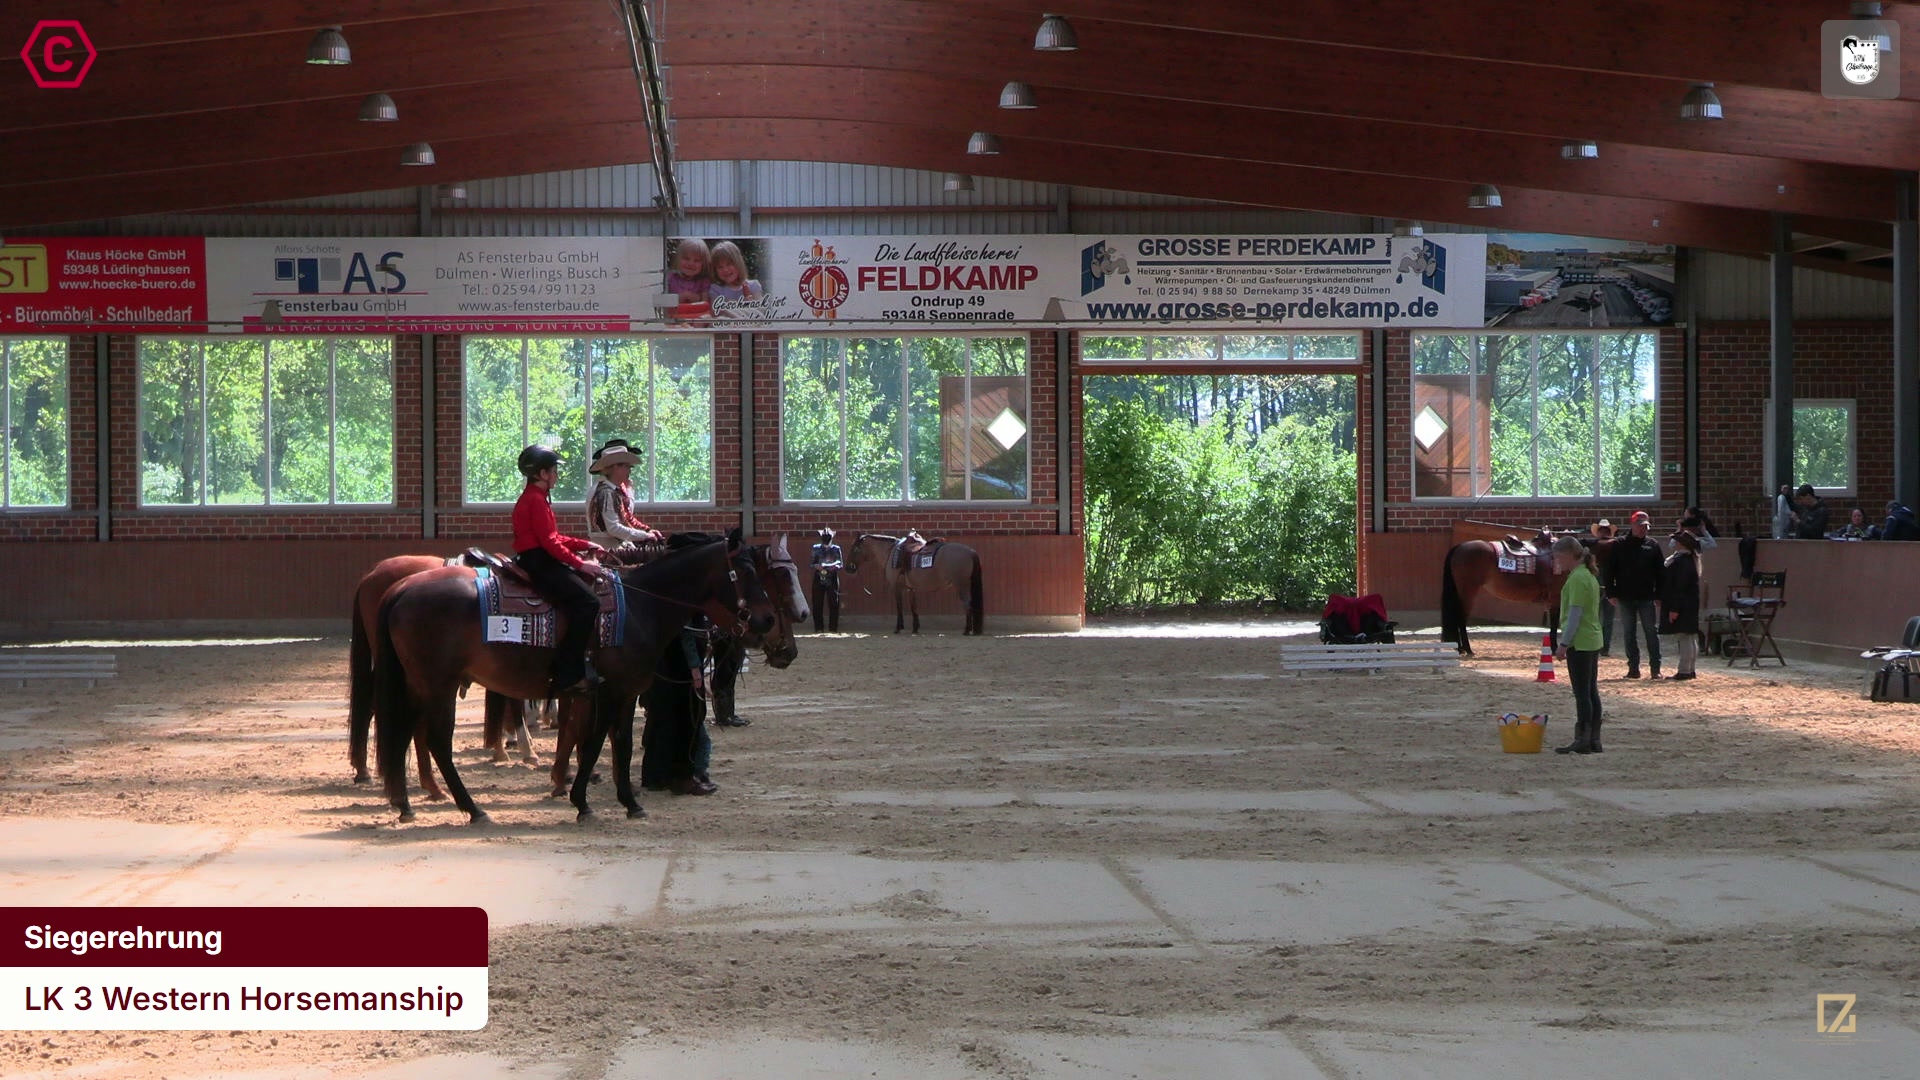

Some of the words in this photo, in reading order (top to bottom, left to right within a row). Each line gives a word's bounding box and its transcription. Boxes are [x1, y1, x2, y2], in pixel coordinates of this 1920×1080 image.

[66, 249, 102, 260] Klaus
[105, 248, 145, 260] Höcke
[147, 249, 187, 260] GmbH
[874, 243, 900, 263] Die
[904, 242, 1021, 266] Landfleischerei
[1138, 238, 1231, 256] GROSSE
[1237, 237, 1376, 257] PERDEKAMP
[457, 252, 474, 263] AS
[479, 251, 553, 264] Fensterbau
[558, 251, 599, 263] GmbH
[63, 264, 100, 275] 59348
[102, 263, 191, 277] Lüdinghausen
[343, 251, 407, 294] AS
[436, 267, 489, 280] Dülmen
[501, 266, 562, 282] Wierlings
[568, 267, 608, 279] Busch
[612, 267, 620, 279] 3
[1137, 267, 1171, 276] Heizung
[1178, 267, 1209, 275] Sanitär
[1216, 267, 1267, 275] Brunnenbau
[1274, 267, 1297, 275] Solar
[1304, 267, 1392, 276] Erdwärmebohrungen
[59, 279, 196, 290] www.hoecke-buero.de
[858, 265, 1039, 291] FELDKAMP
[1154, 276, 1218, 285] Wärmepumpen
[1259, 276, 1374, 285] Gasfeuerungskundendienst
[463, 283, 489, 296] Tel.:
[800, 283, 848, 309] FELDKAMP
[1137, 287, 1154, 296] Tel.
[1243, 286, 1299, 297] Dernekamp
[1302, 286, 1314, 295] 35
[1321, 286, 1351, 295] 48249
[1353, 286, 1391, 295] Dülmen
[362, 299, 407, 312] GmbH
[458, 300, 599, 312] www.as-fensterbau.de
[713, 295, 770, 314] Geschmack
[772, 296, 787, 308] ist
[911, 295, 965, 309] Ondrup
[967, 295, 985, 307] 49
[106, 305, 193, 323] Schulbedarf
[1086, 297, 1440, 323] www.grosse-perdekamp.de
[501, 618, 509, 634] 3
